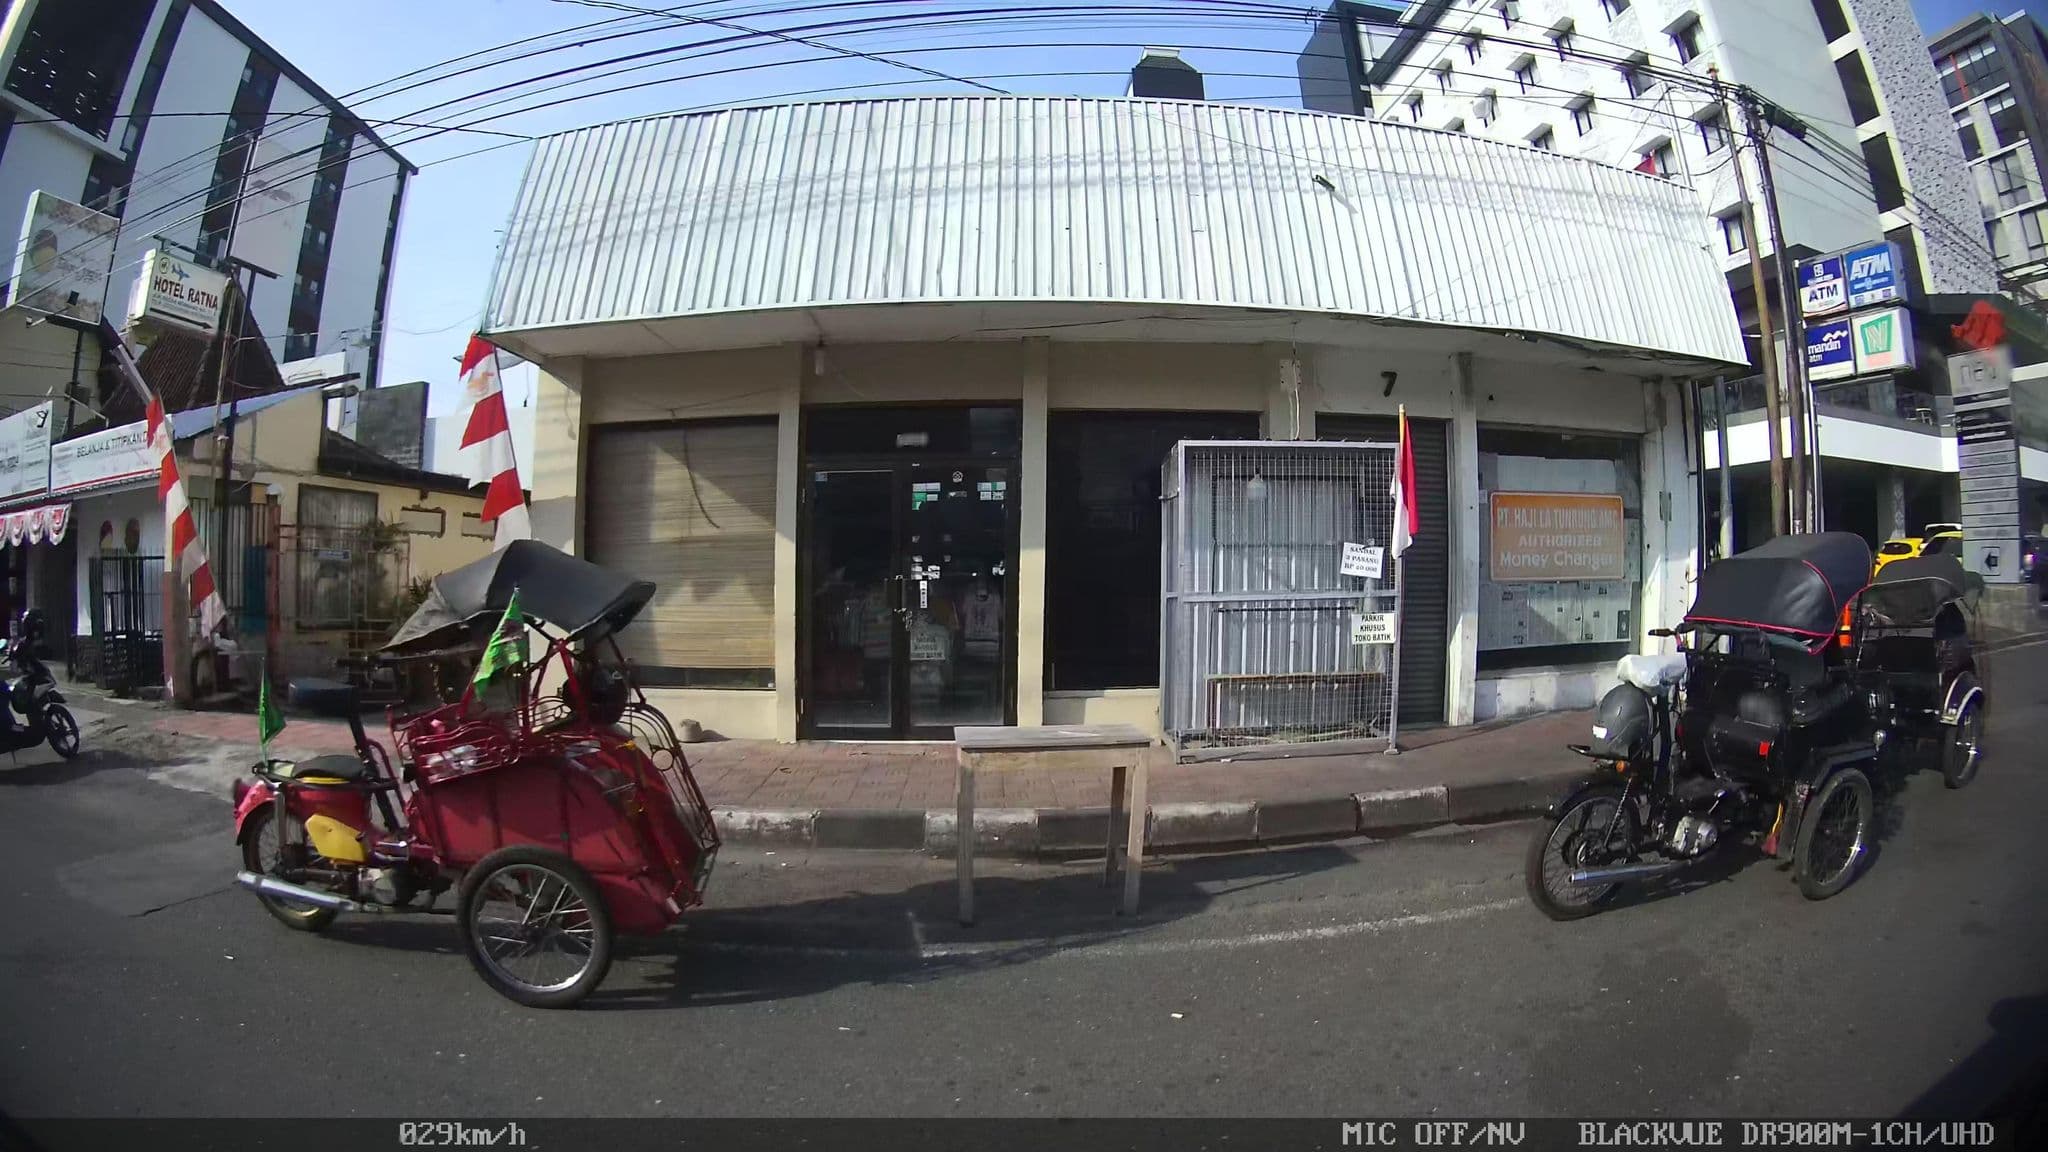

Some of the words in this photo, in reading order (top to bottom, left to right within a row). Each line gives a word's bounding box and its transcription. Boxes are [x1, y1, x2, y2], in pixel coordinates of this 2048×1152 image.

[1849, 252, 1891, 281] ATM
[154, 275, 185, 299] HOTEL
[187, 287, 218, 310] RATNA
[1808, 284, 1839, 303] ATM
[1808, 354, 1823, 363] atm
[1380, 370, 1398, 397] 7
[76, 442, 104, 459] BELANJA
[1519, 534, 1602, 548] AUTHORIZED
[1500, 551, 1550, 569] Money
[1553, 549, 1617, 571] Changer
[1362, 614, 1384, 622] PARKIR
[1360, 624, 1386, 633] KHUSUS
[1355, 634, 1372, 642] TOKO
[1372, 633, 1391, 641] BATIK
